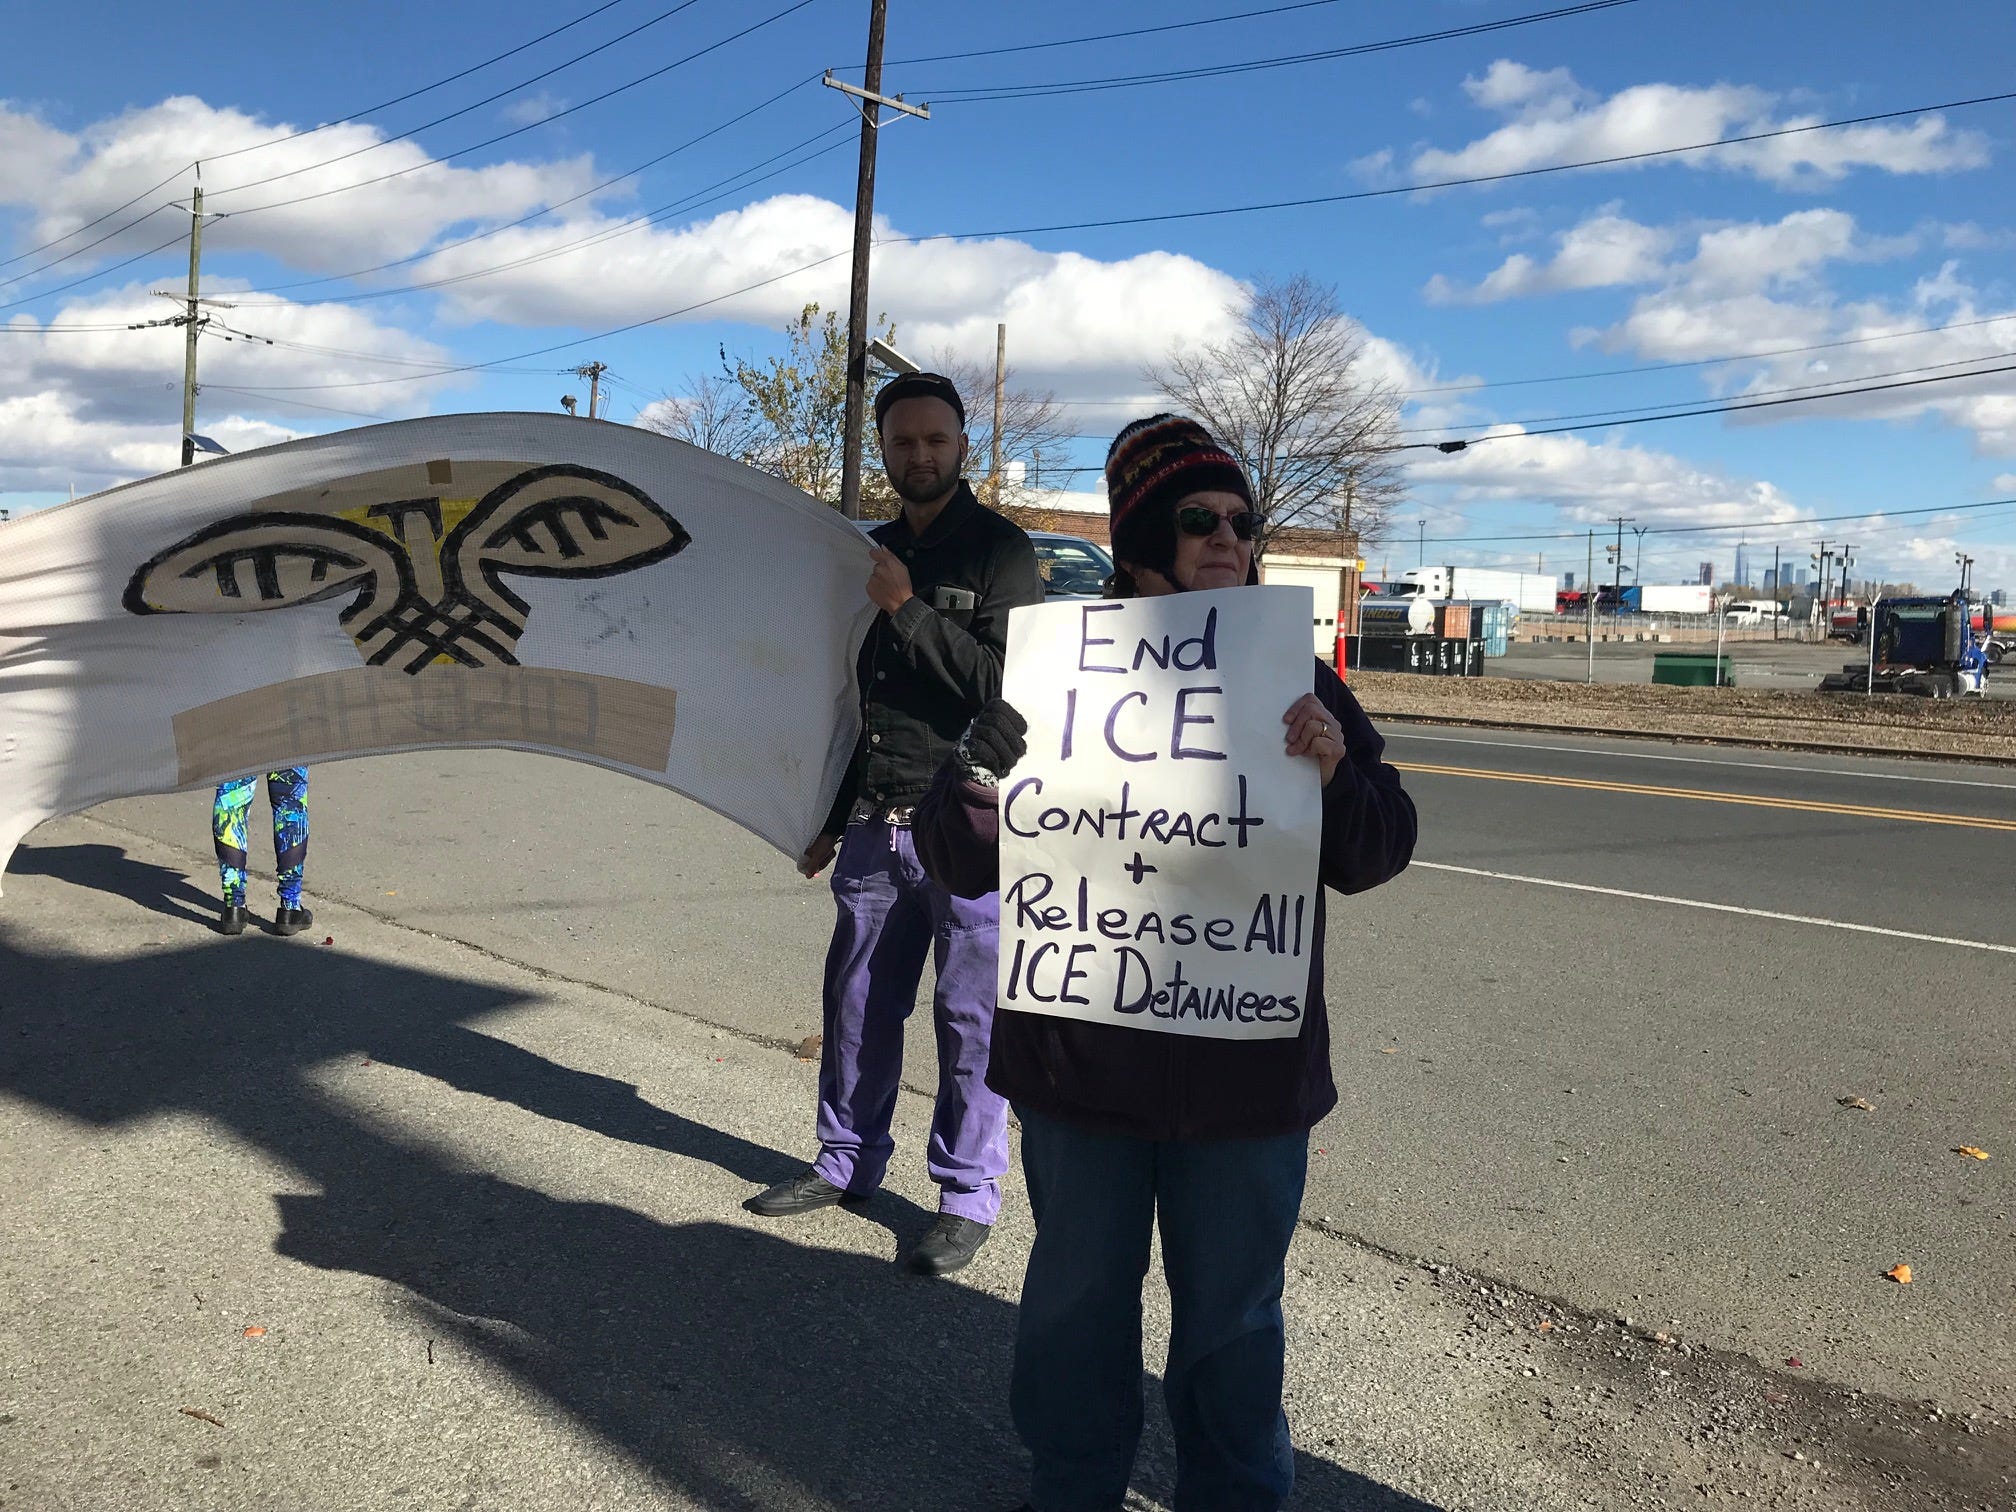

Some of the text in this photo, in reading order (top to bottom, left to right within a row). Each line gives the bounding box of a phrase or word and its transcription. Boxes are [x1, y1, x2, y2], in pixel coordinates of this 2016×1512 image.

[1061, 686, 1228, 762] ICE
[1124, 852, 1157, 885] +
[1244, 893, 1305, 957] All
[1007, 939, 1097, 1005] ICE
